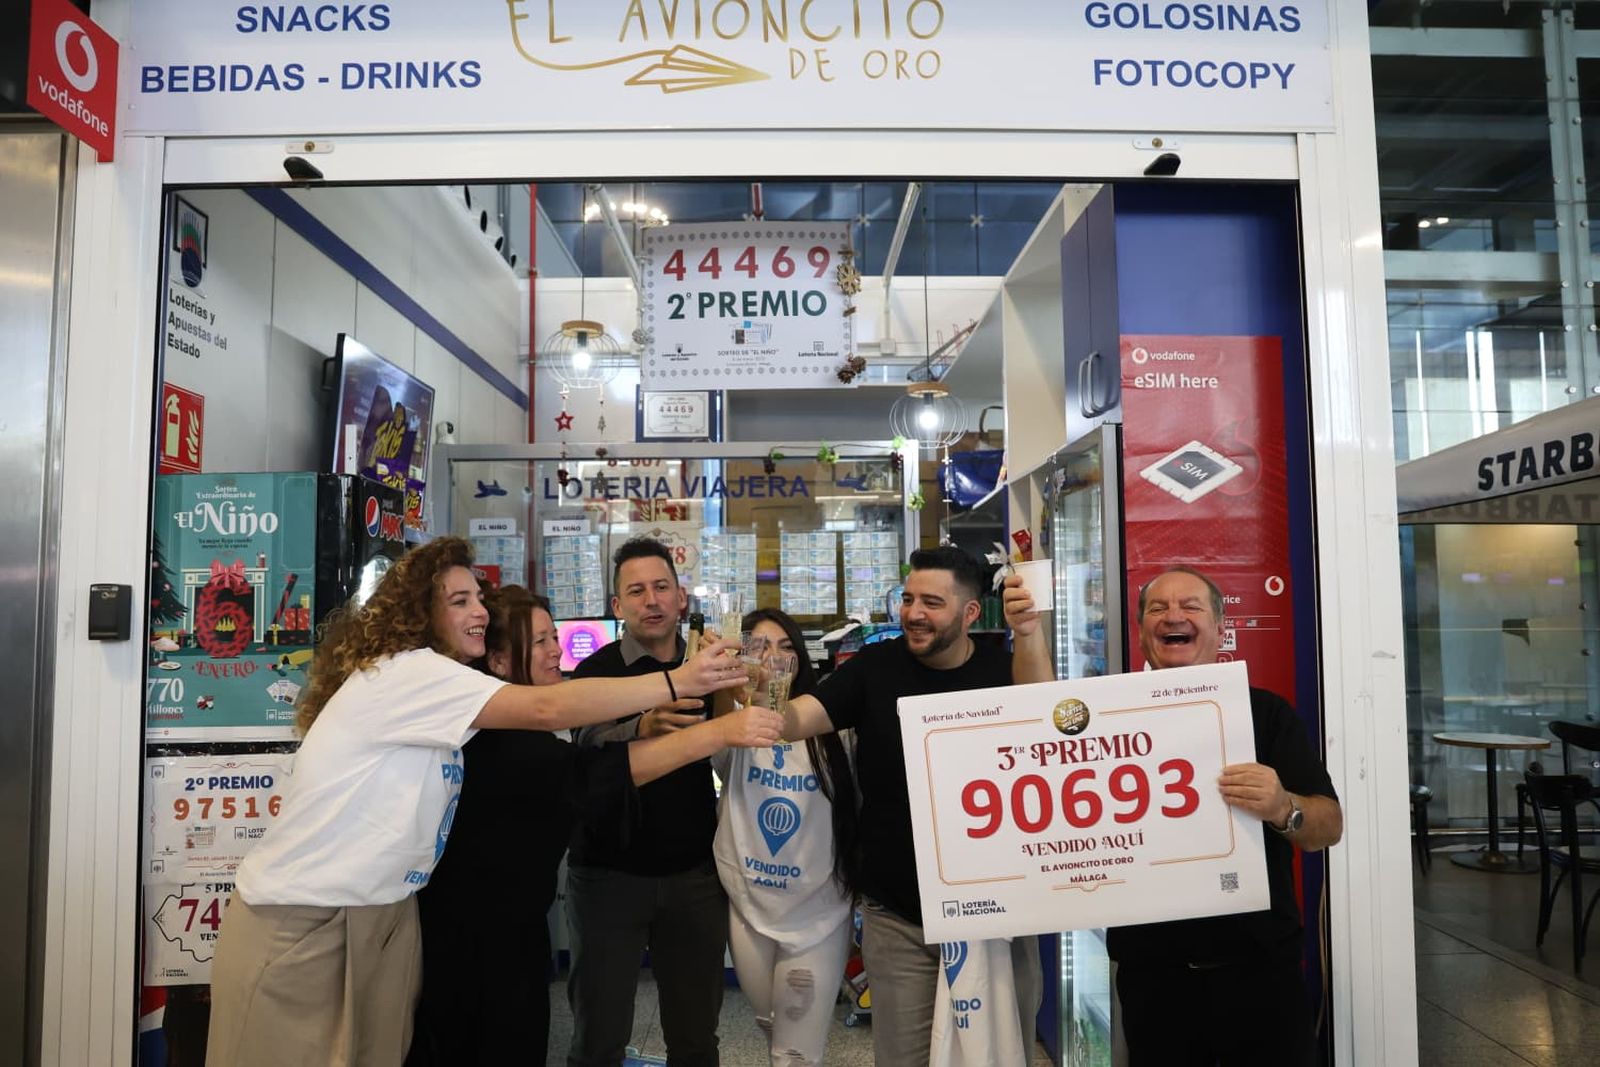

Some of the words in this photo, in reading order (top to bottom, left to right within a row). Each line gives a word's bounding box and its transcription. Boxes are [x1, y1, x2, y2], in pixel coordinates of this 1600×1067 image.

[235, 3, 391, 33] SNACKS
[509, 0, 573, 43] EL
[1085, 2, 1301, 33] GOLOSINAS
[141, 63, 305, 94] BEBIDAS
[341, 60, 482, 90] DRINKS
[789, 48, 835, 82] DE
[863, 48, 941, 80] ORO
[1094, 59, 1296, 90] FOTOCOPY
[38, 75, 109, 138] vodafone
[663, 246, 831, 281] 44469
[698, 290, 827, 319] PREMIO
[168, 311, 212, 343] Apuestas
[214, 334, 227, 350] del
[210, 312, 216, 326] y
[167, 333, 200, 359] Estado
[1150, 351, 1195, 362] vodafone
[1134, 373, 1175, 389] eSIM
[1180, 373, 1218, 389] here
[1478, 432, 1600, 491] STARB
[544, 475, 672, 500] LOTERIA
[682, 475, 809, 500] VIAJERA
[173, 511, 193, 528] El
[193, 501, 278, 537] Niño
[1223, 596, 1240, 604] rice
[195, 662, 257, 679] ENERO
[1152, 690, 1162, 698] 22
[1162, 689, 1172, 697] de
[1174, 684, 1219, 697] Diciembre
[955, 712, 965, 720] de
[1030, 731, 1153, 767] PREMIO
[208, 775, 274, 790] PREMIO
[748, 766, 820, 792] PREMIO
[173, 795, 283, 821] 97516
[961, 758, 1200, 839] 90693
[1022, 837, 1096, 857] VENDIDO
[1102, 829, 1144, 850] AQUÍ
[745, 857, 800, 877] VENDIDO
[1053, 860, 1100, 871] AVIONCITO
[1115, 856, 1134, 865] ORO
[205, 884, 211, 893] 5
[753, 876, 787, 889] AQUÍ
[962, 899, 997, 910] LOTERÍA
[963, 905, 1006, 917] NACIONAL
